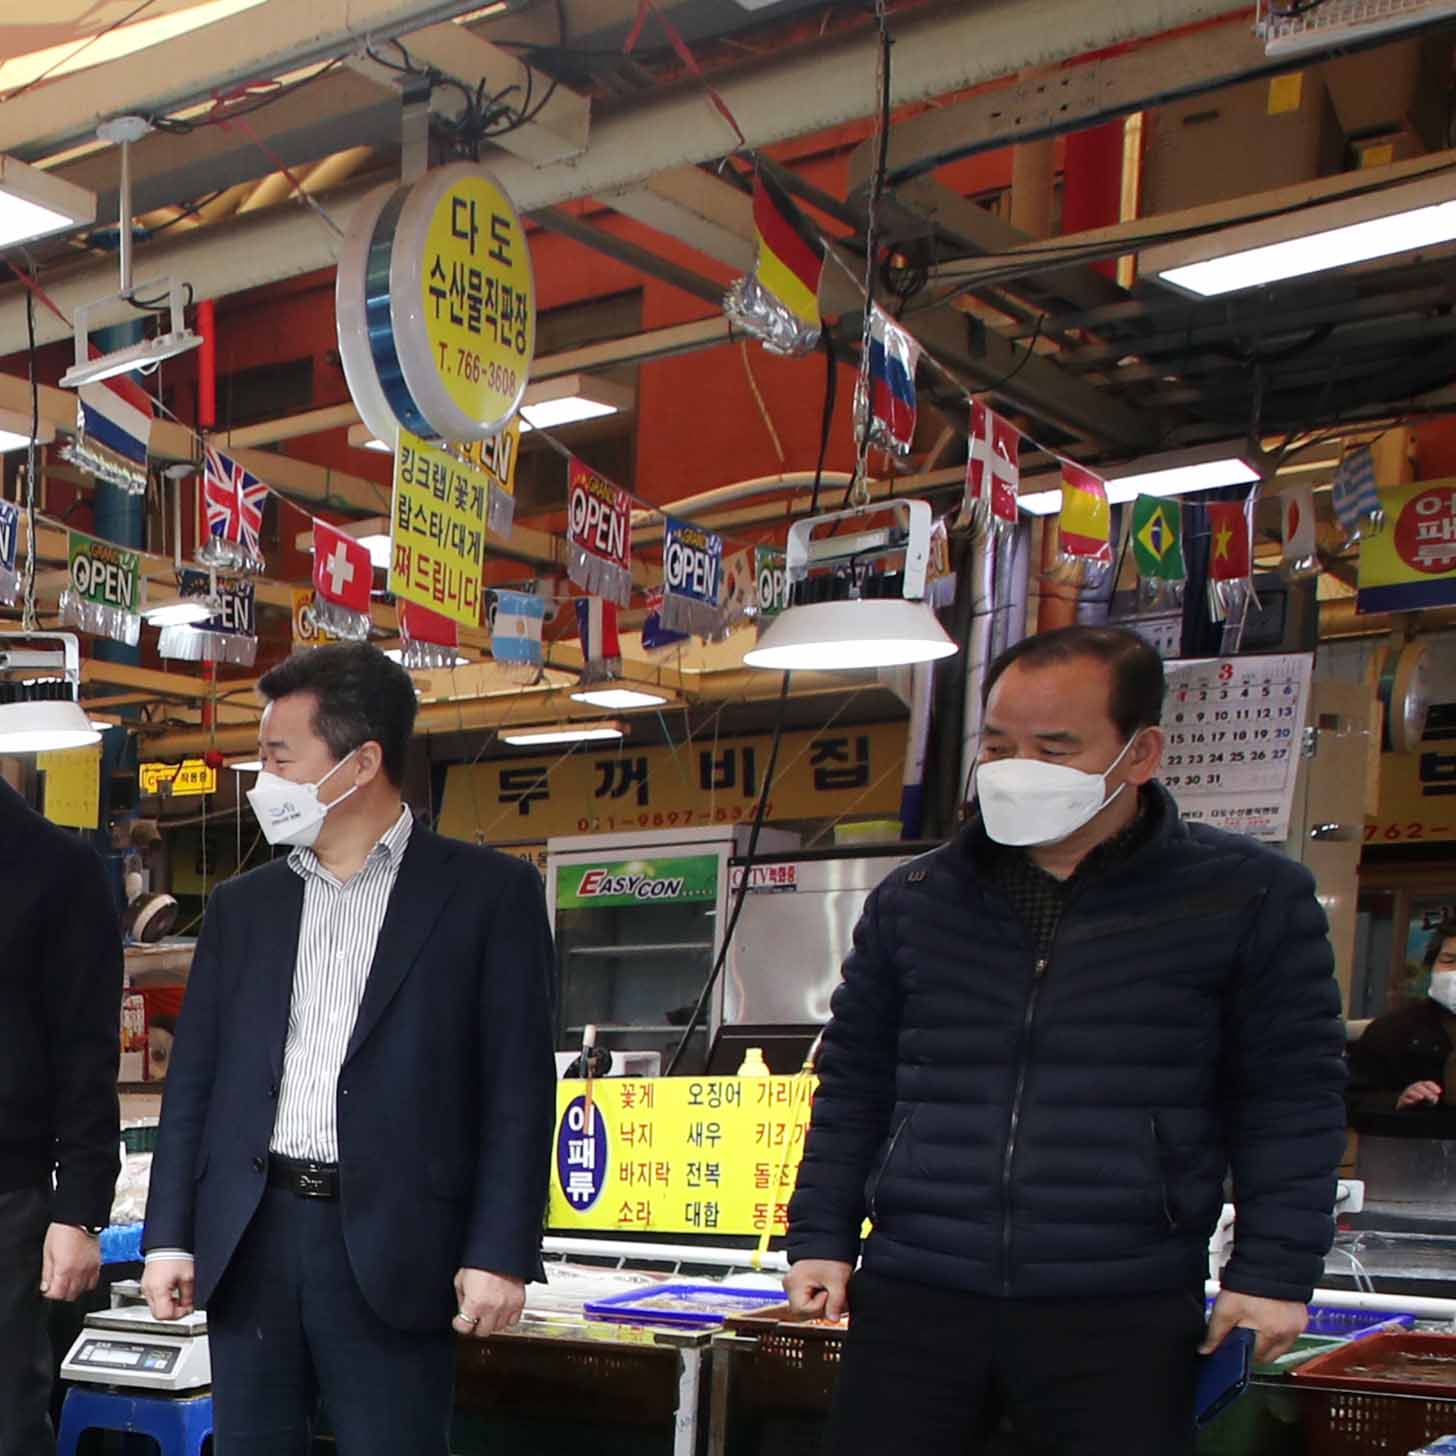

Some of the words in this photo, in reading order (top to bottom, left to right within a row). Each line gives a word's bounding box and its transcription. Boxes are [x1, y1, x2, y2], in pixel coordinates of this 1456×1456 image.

[451, 195, 513, 268] 다도
[428, 253, 528, 356] 수산물직판장
[400, 447, 484, 521] 킹크랩/꽃게
[398, 494, 481, 567] 랍스타/대게
[570, 486, 625, 559] OPEN
[72, 554, 132, 609] OPEN
[667, 542, 716, 597] OPEN
[1217, 663, 1234, 681] 3
[578, 870, 681, 898] EASYCON
[620, 1082, 655, 1109] 꽃게
[688, 1081, 741, 1108] 오징어
[619, 1121, 654, 1148] 낙지
[686, 1121, 722, 1149] 새우
[619, 1161, 671, 1187] 바지락
[685, 1162, 721, 1188] 전복
[618, 1201, 652, 1228] 소라
[684, 1202, 721, 1229] 대합
